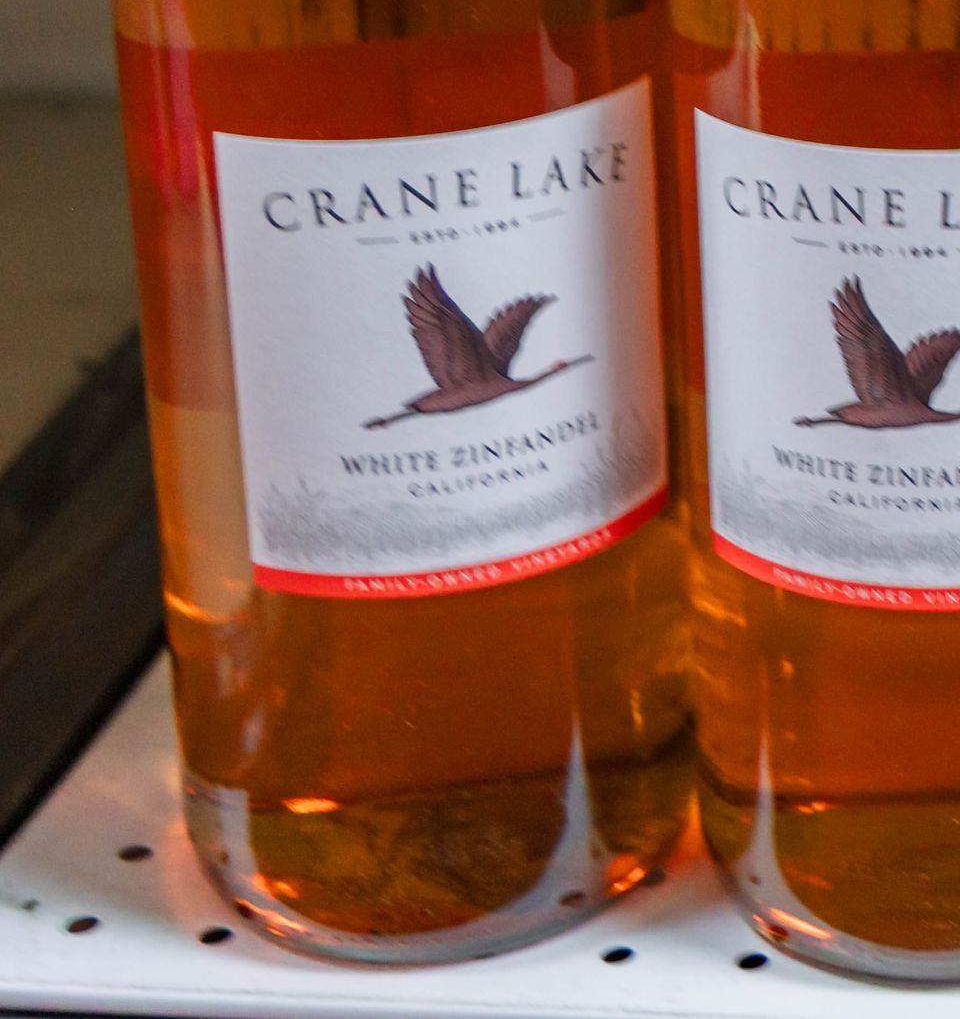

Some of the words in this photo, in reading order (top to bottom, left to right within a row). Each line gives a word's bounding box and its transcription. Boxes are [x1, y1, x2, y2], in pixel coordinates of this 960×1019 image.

[262, 168, 479, 232] CRANE
[509, 142, 628, 199] LAKE
[723, 177, 907, 228] CRANE
[339, 450, 440, 477] WHITE
[450, 411, 602, 468] ZINFANDEL
[772, 445, 857, 482] WHITE
[408, 458, 549, 498] CALIFORNIA
